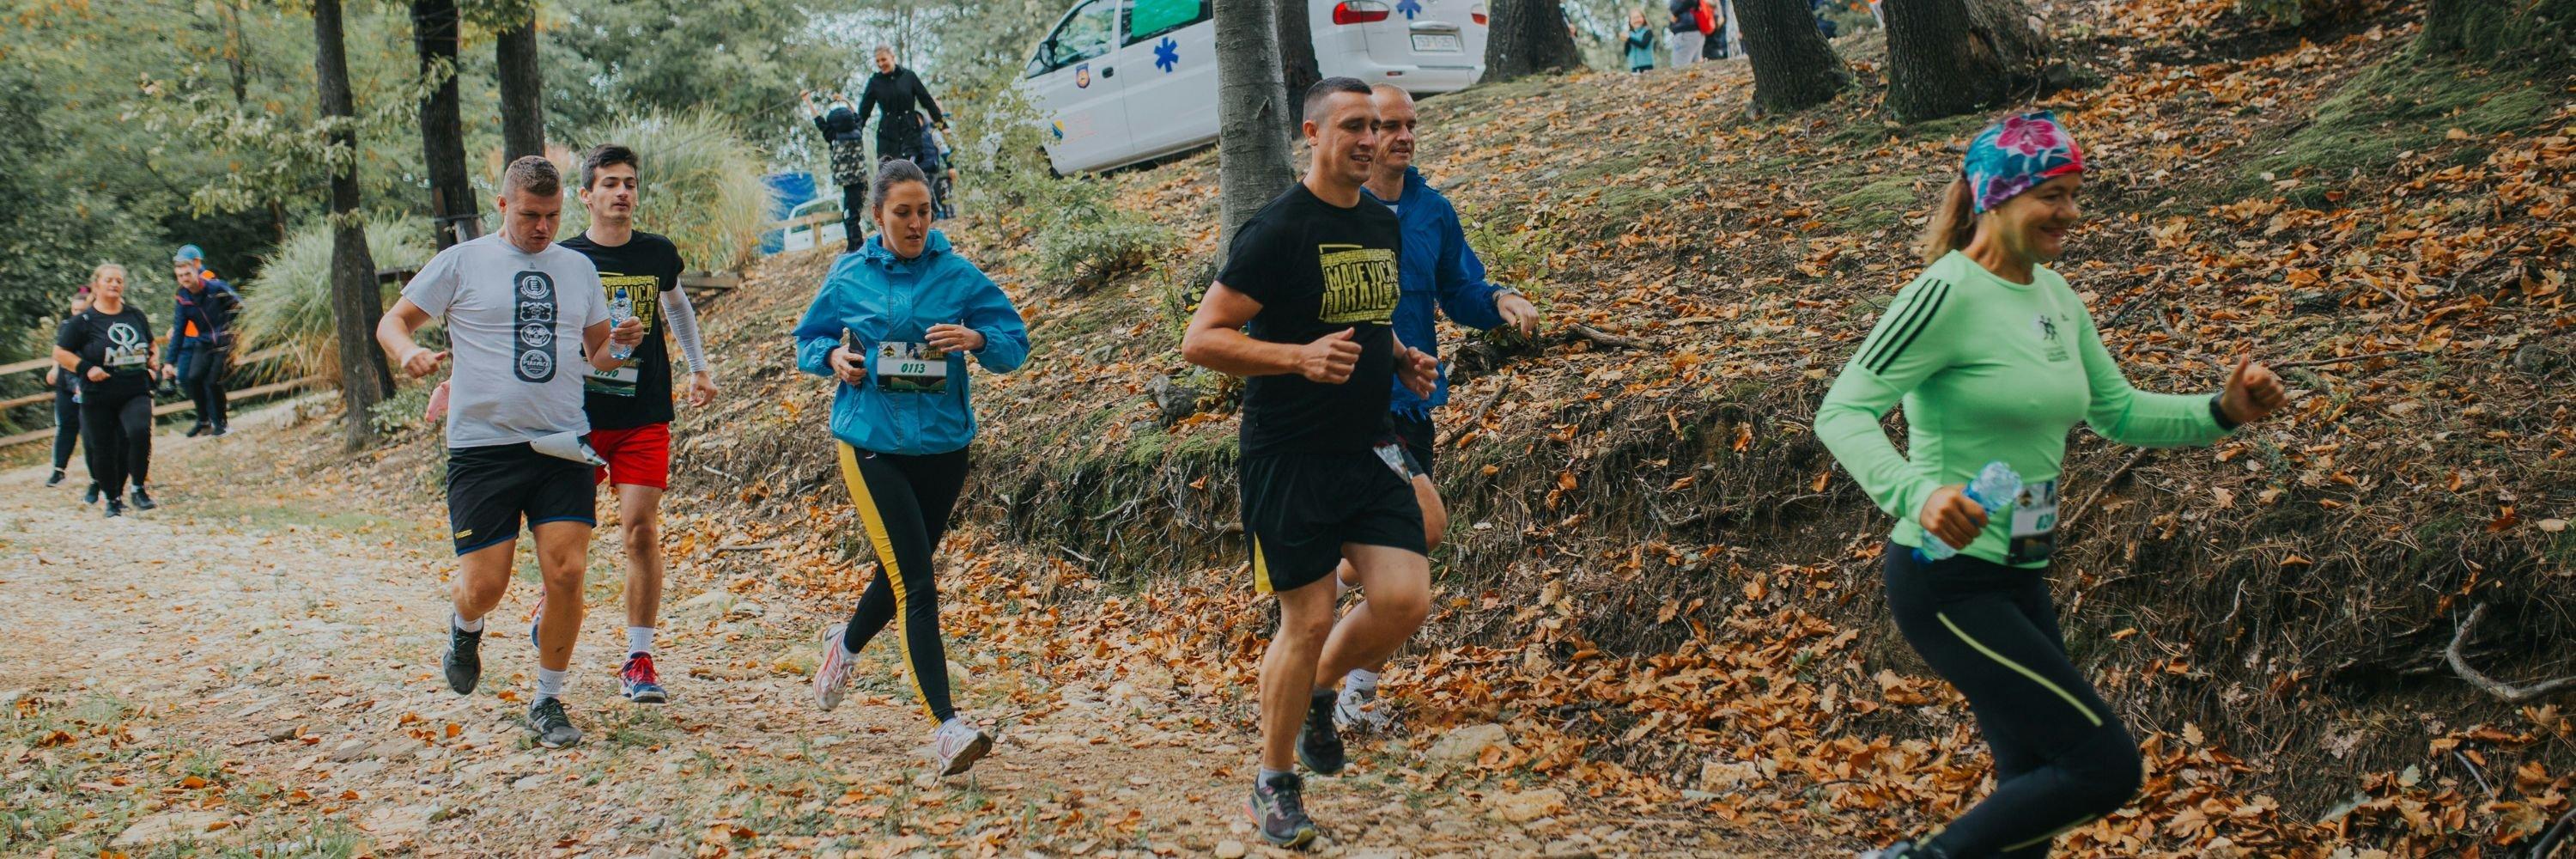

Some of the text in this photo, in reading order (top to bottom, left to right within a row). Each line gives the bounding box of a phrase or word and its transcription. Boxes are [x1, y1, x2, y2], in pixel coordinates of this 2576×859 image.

[1325, 260, 1397, 292] MAJEVICA
[1331, 282, 1388, 313] TRAIL
[901, 362, 926, 374] 0113
